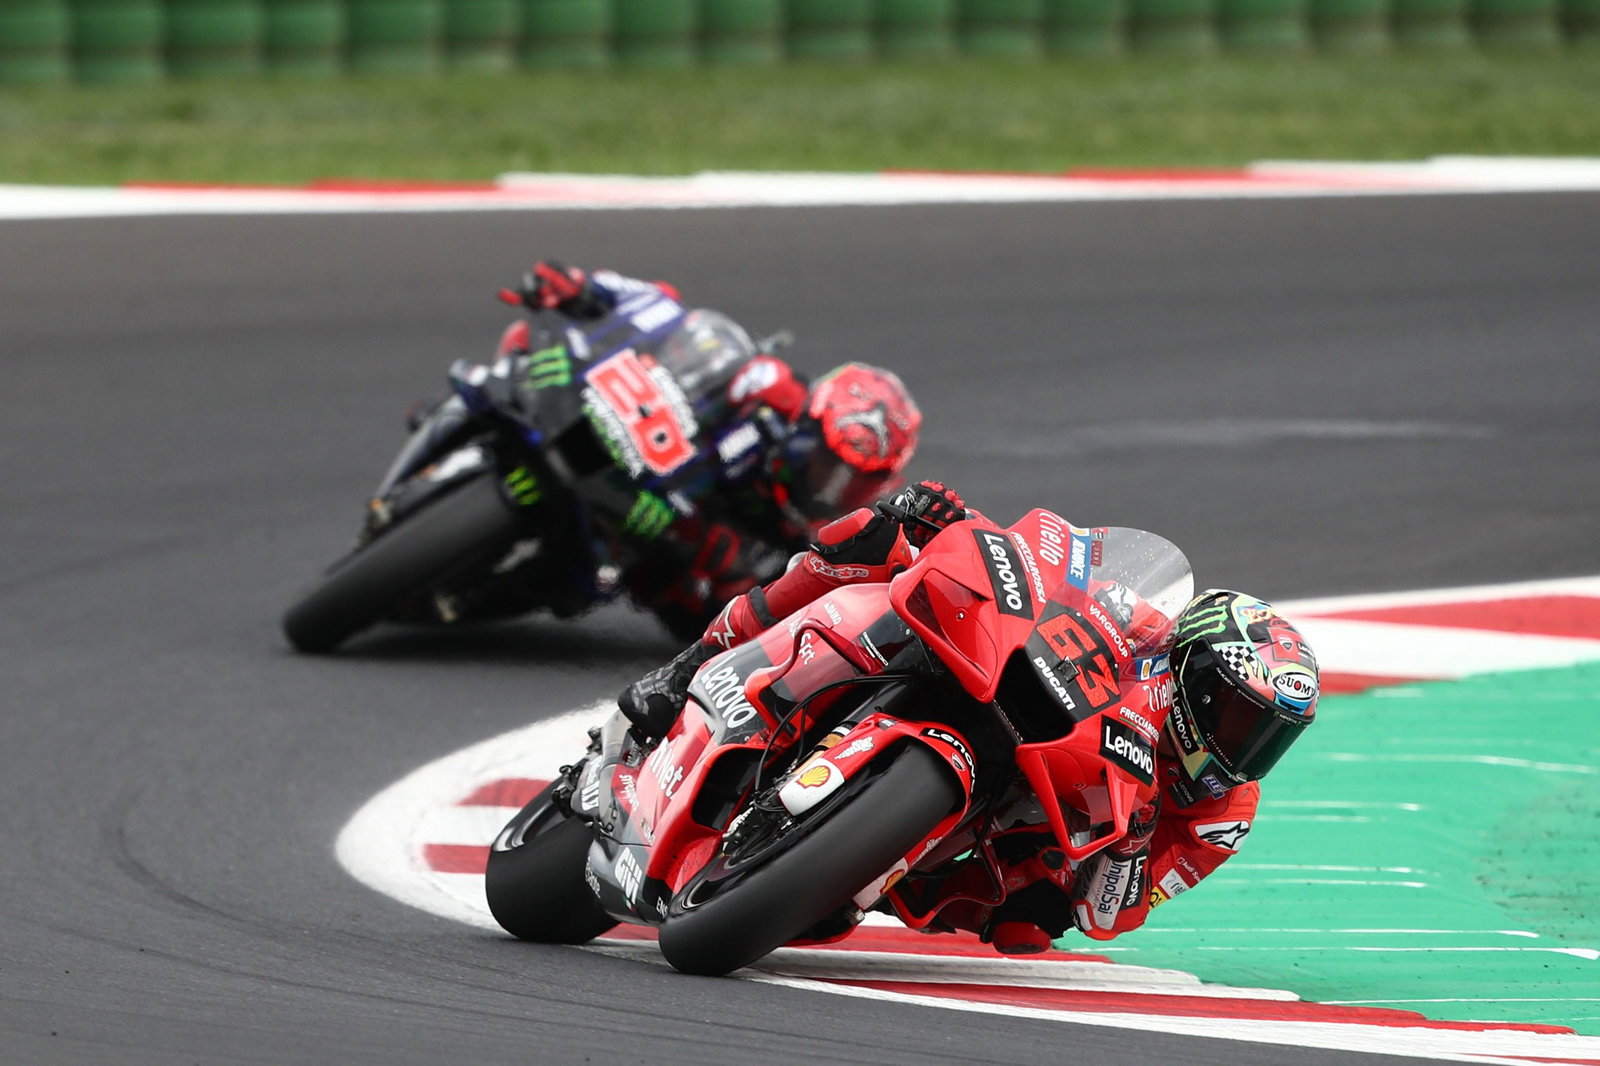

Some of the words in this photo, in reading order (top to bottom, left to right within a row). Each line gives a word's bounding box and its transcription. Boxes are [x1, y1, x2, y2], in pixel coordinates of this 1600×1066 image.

[1010, 531, 1047, 604] FRECCIAROSSA
[1039, 518, 1065, 566] riello
[984, 533, 1023, 610] Lenovo
[1033, 656, 1076, 711] DUCATI
[1037, 613, 1120, 708] 63
[701, 653, 757, 728] Lenovo
[1105, 726, 1153, 775] Lenovo
[1172, 697, 1192, 750] Lenovo
[1206, 776, 1222, 792] FLE
[1126, 855, 1147, 906] Lenovo
